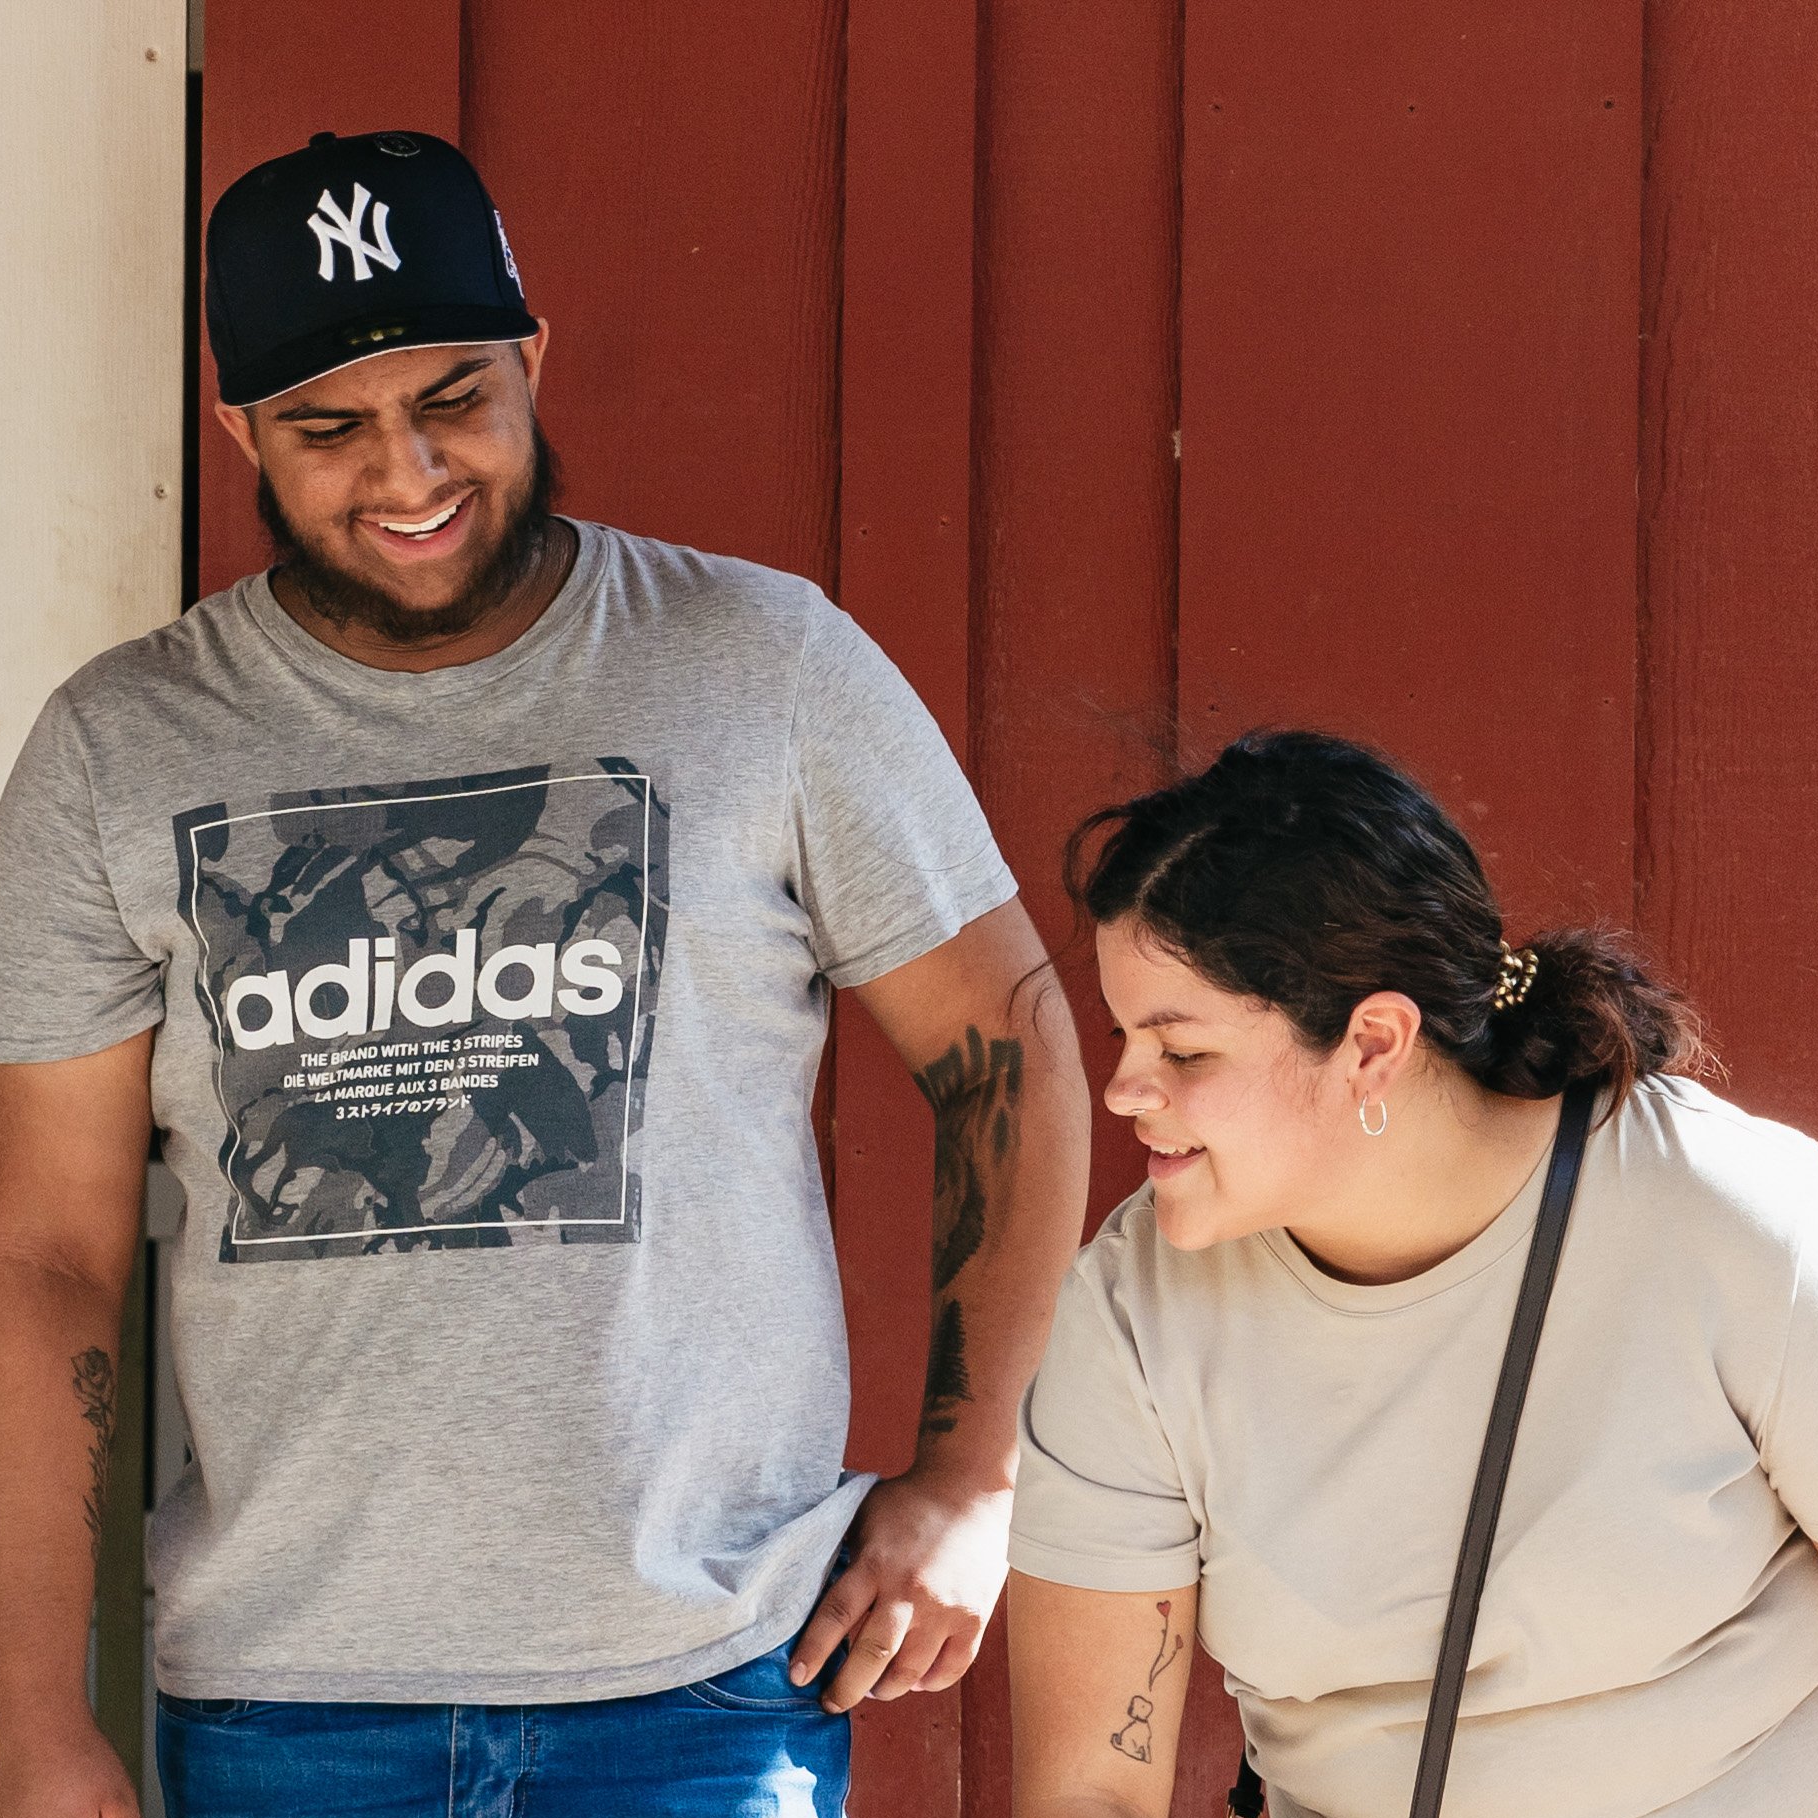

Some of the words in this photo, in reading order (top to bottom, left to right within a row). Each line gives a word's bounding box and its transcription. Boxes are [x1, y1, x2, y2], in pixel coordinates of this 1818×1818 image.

[306, 181, 402, 282] NY
[226, 929, 624, 1051] adidas
[300, 1053, 328, 1068] THE
[330, 1046, 378, 1066] BRAND
[381, 1042, 419, 1058] WITH
[421, 1039, 450, 1055] THE
[452, 1038, 461, 1051] 3
[463, 1034, 523, 1051] STRIPES
[283, 1073, 306, 1089] DIE
[307, 1063, 393, 1088] WELTMARKE
[395, 1060, 422, 1076] MIT
[423, 1058, 455, 1074] DEN
[456, 1056, 466, 1070] 3
[468, 1053, 540, 1069] STREIFEN
[314, 1090, 332, 1104] LA
[333, 1083, 394, 1101] MARQUE
[396, 1080, 427, 1096] AUX
[428, 1078, 438, 1092] 3
[440, 1073, 499, 1091] BANDES
